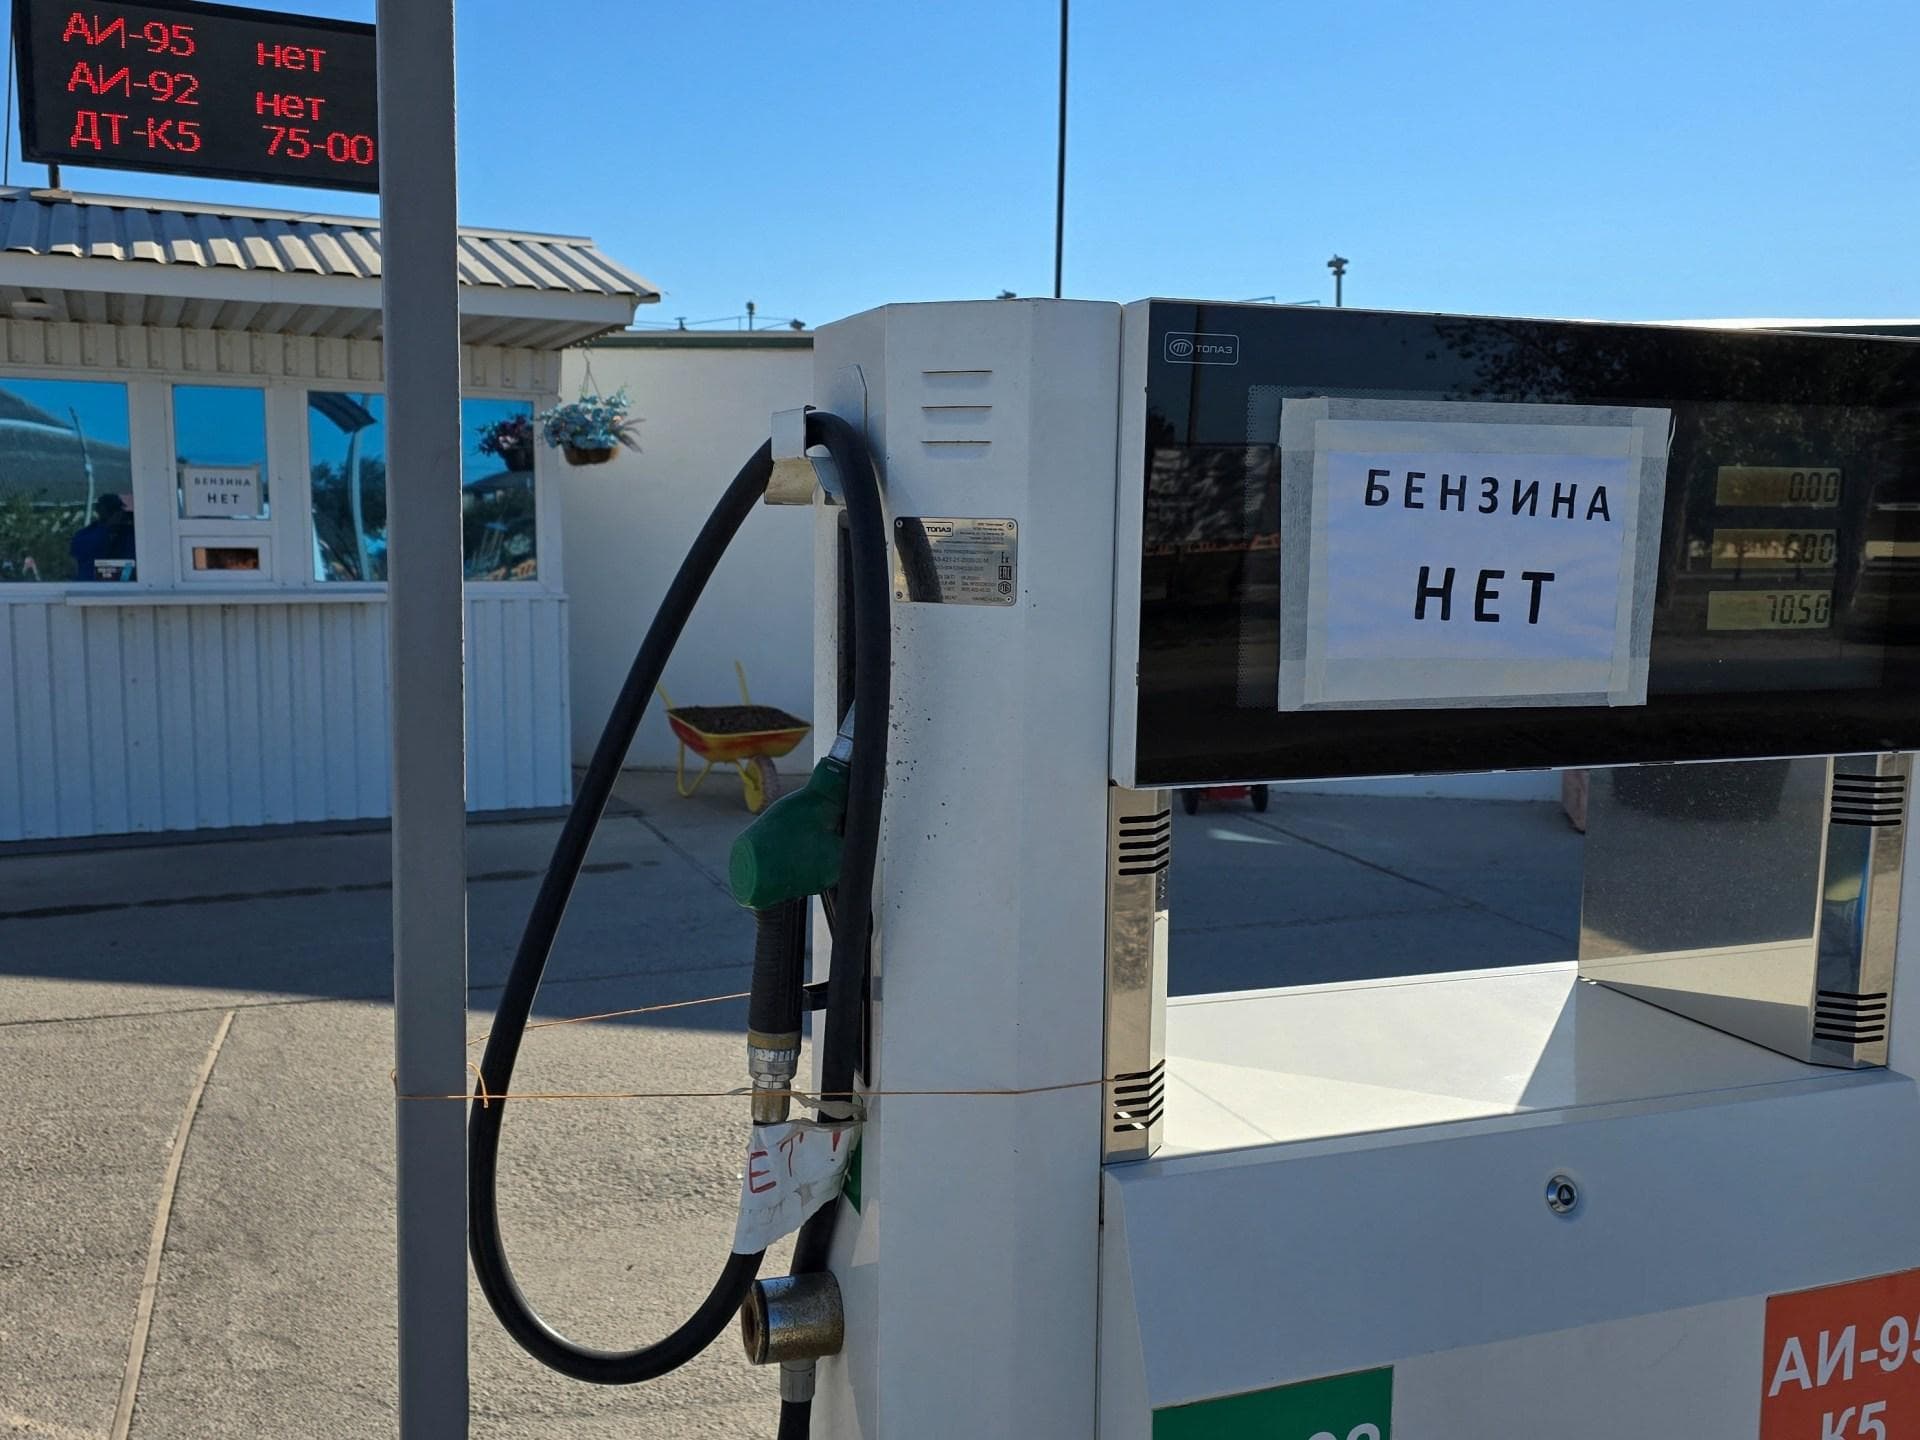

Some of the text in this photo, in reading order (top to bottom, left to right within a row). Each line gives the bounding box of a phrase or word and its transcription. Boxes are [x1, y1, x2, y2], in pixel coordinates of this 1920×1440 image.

[62, 11, 198, 57] АИ-95
[67, 60, 200, 106] АИ-92
[69, 110, 375, 165] ДТ-К5 75-00
[1195, 344, 1233, 355] ТОПАЗ
[207, 492, 242, 505] НЕТ
[1364, 468, 1612, 523] БЕНЗИНА
[1413, 565, 1556, 625] НЕТ
